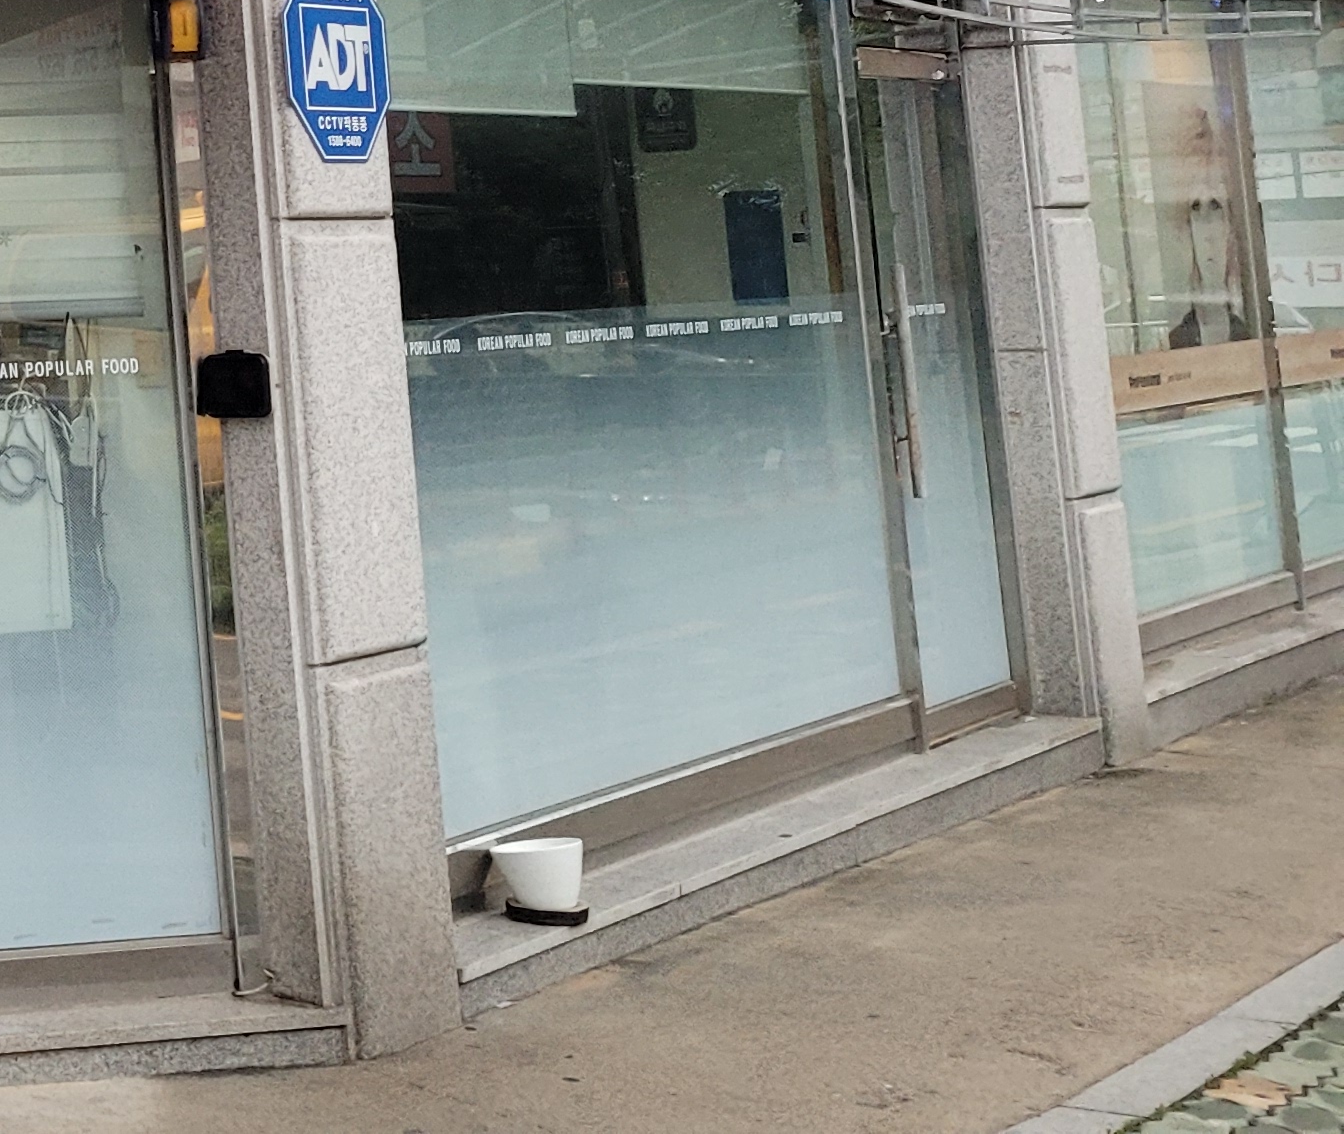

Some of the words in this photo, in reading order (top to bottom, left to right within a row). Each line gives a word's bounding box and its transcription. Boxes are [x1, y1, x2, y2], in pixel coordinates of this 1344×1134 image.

[307, 22, 370, 92] ADT
[477, 336, 504, 351] KOREAN
[504, 334, 534, 349] POPULAR
[535, 332, 552, 347] FOOD
[565, 329, 590, 344] KOREAN
[590, 327, 617, 342] POPULAR
[618, 326, 634, 340] FOOD
[409, 339, 442, 356] POPULAR
[443, 339, 461, 354] FOOD
[25, 360, 94, 378] POPULAR
[101, 358, 140, 374] FOOD
